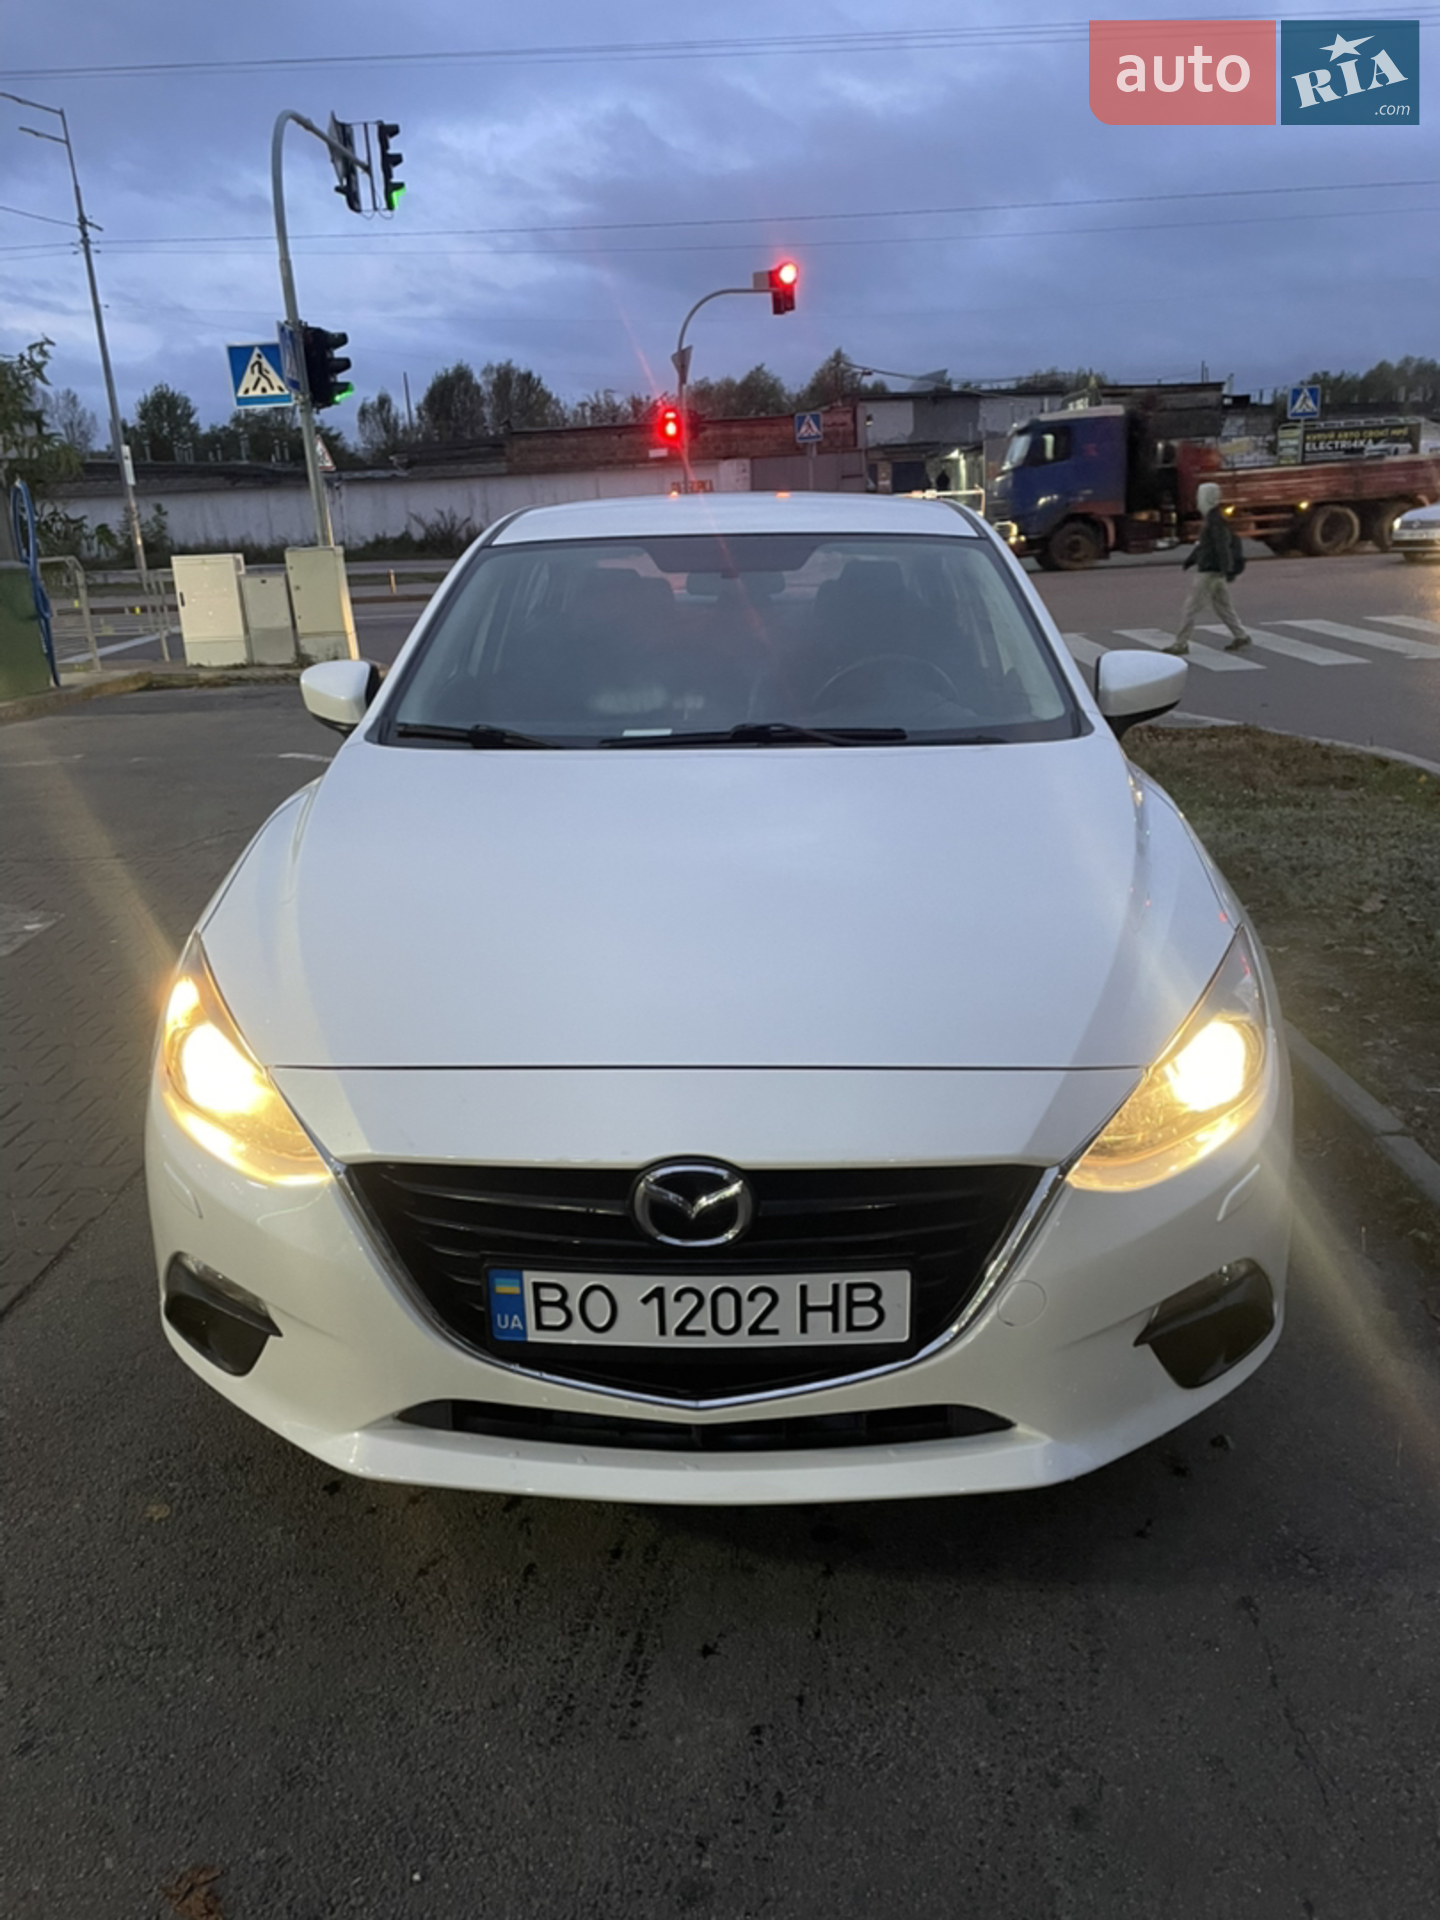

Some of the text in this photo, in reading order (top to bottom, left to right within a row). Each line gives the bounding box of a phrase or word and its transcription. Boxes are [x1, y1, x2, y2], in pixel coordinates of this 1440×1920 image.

[1337, 430, 1361, 440] АВТО
[497, 1281, 886, 1337] UA BO 1202 HB
